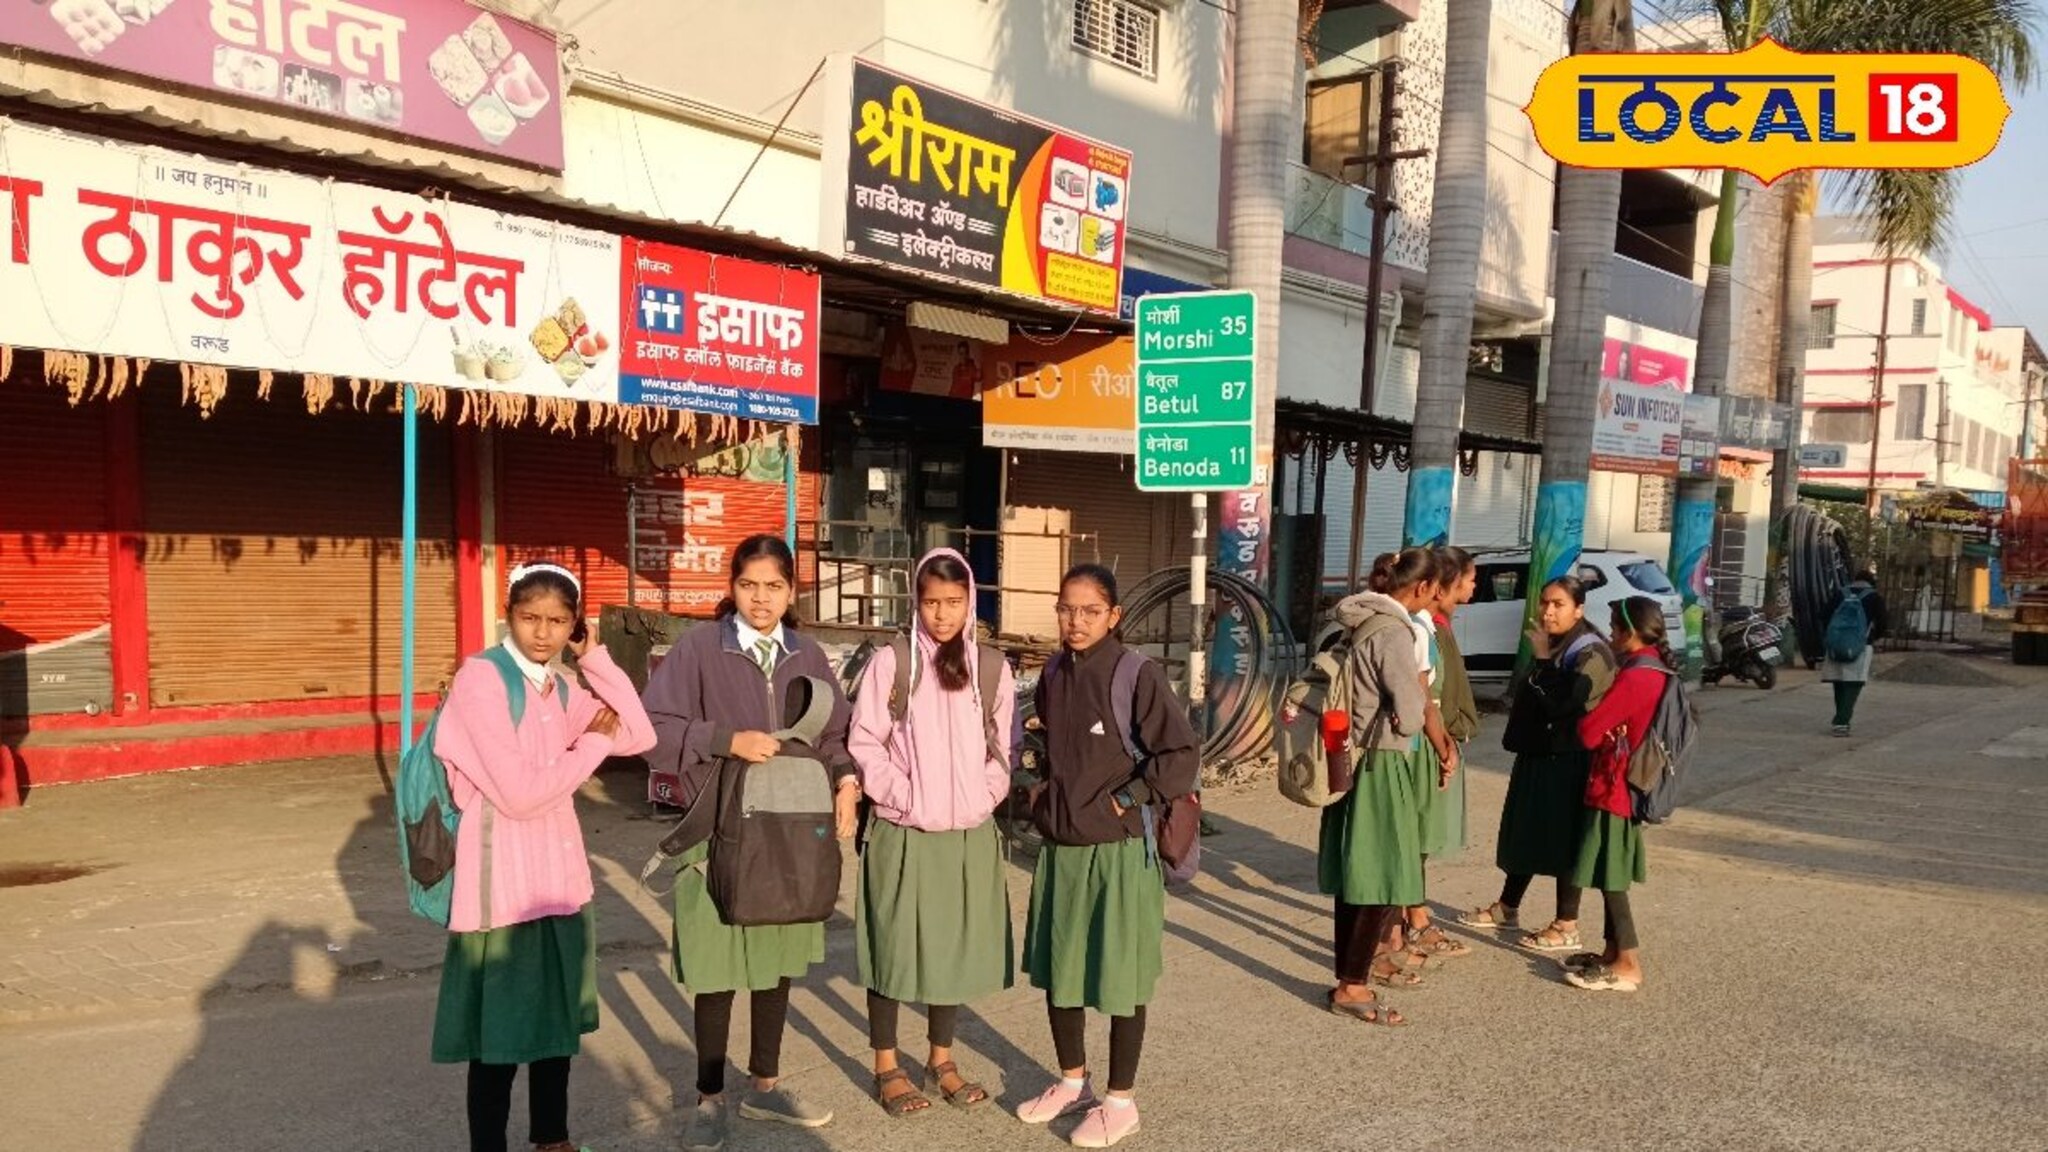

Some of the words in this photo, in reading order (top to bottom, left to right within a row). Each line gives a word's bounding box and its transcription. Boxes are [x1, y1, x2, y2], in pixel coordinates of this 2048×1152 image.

[855, 84, 1015, 208] श्रीराम
[78, 187, 311, 319] ठाकुर
[338, 205, 525, 328] हॉटेल
[694, 292, 804, 350] इसाफ
[1220, 316, 1246, 335] 35
[1145, 329, 1213, 350] Morshi
[636, 341, 679, 360] इसाफ
[996, 361, 1063, 399] REO
[1221, 382, 1246, 400] 87
[1145, 394, 1199, 414] Betul
[1614, 392, 1636, 418] SUN
[1230, 446, 1245, 465] 11
[1145, 457, 1220, 477] Benoda
